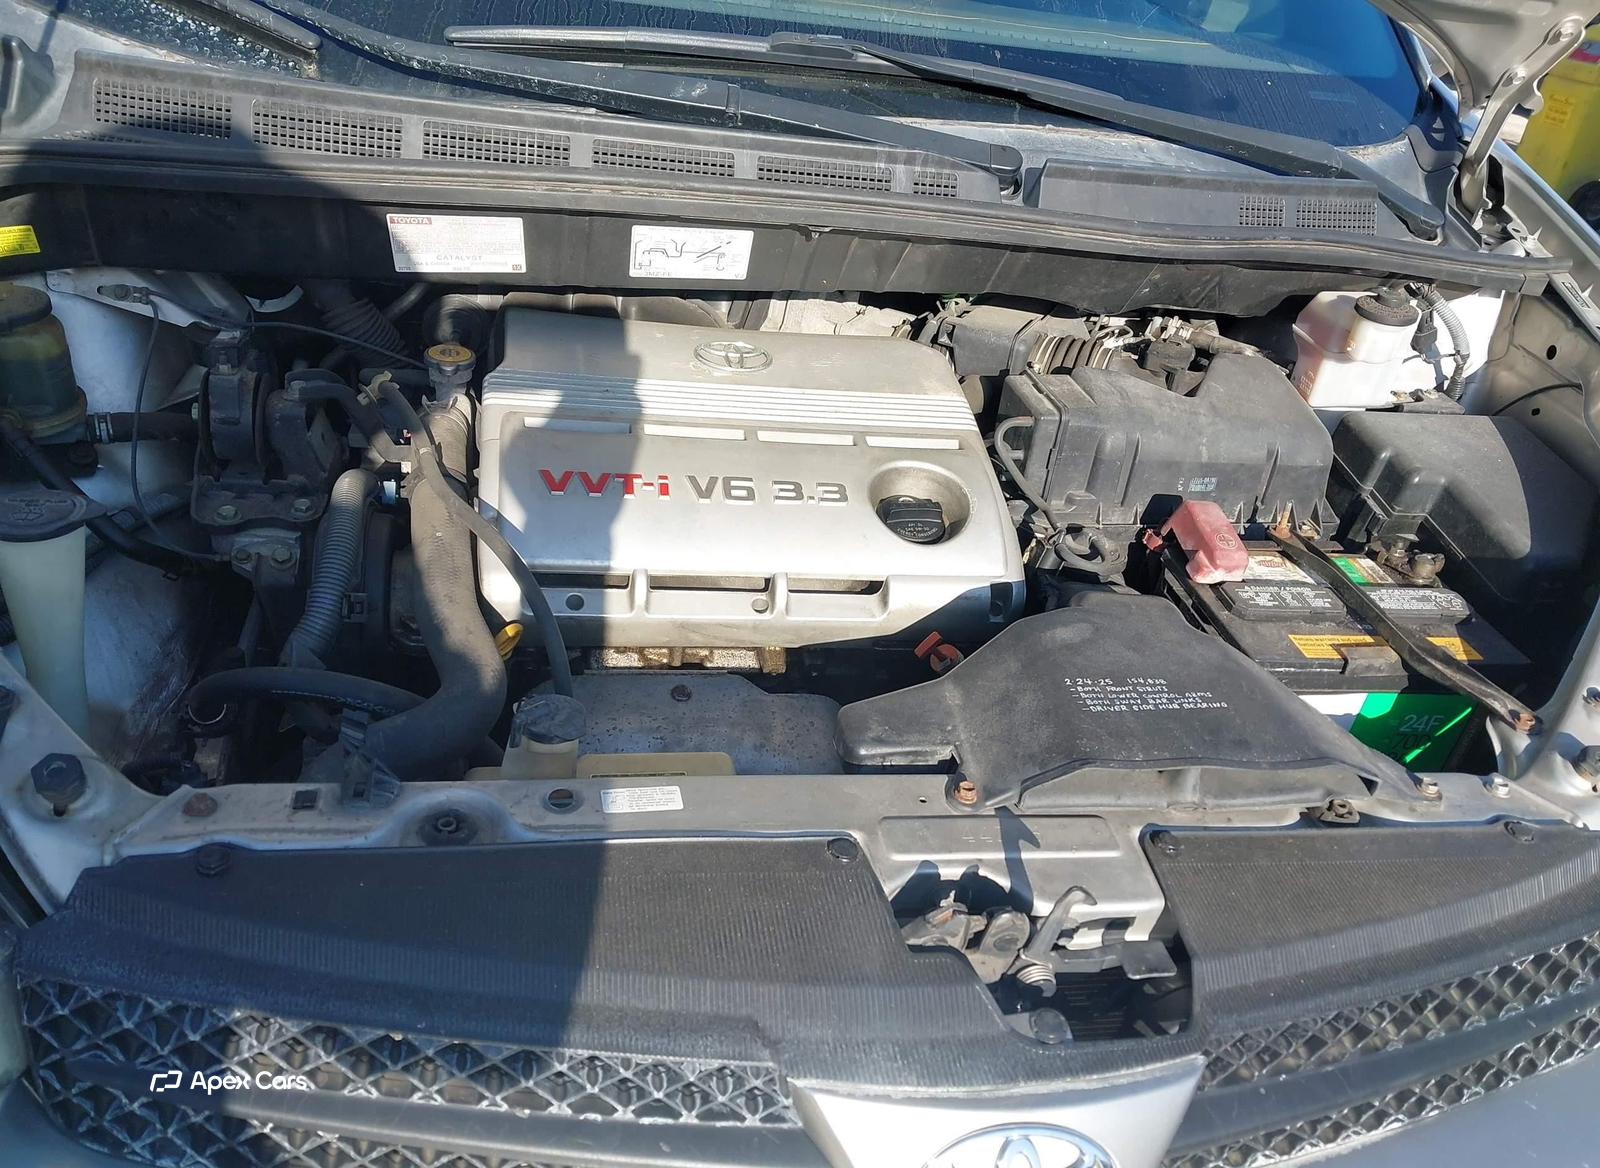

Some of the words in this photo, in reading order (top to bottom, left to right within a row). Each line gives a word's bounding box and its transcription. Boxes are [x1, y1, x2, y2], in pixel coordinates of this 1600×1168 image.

[393, 216, 430, 224] TOYOTA
[538, 469, 671, 499] VVT-i
[684, 474, 757, 505] V6
[771, 480, 850, 507] 3.3
[1398, 714, 1445, 732] 24F
